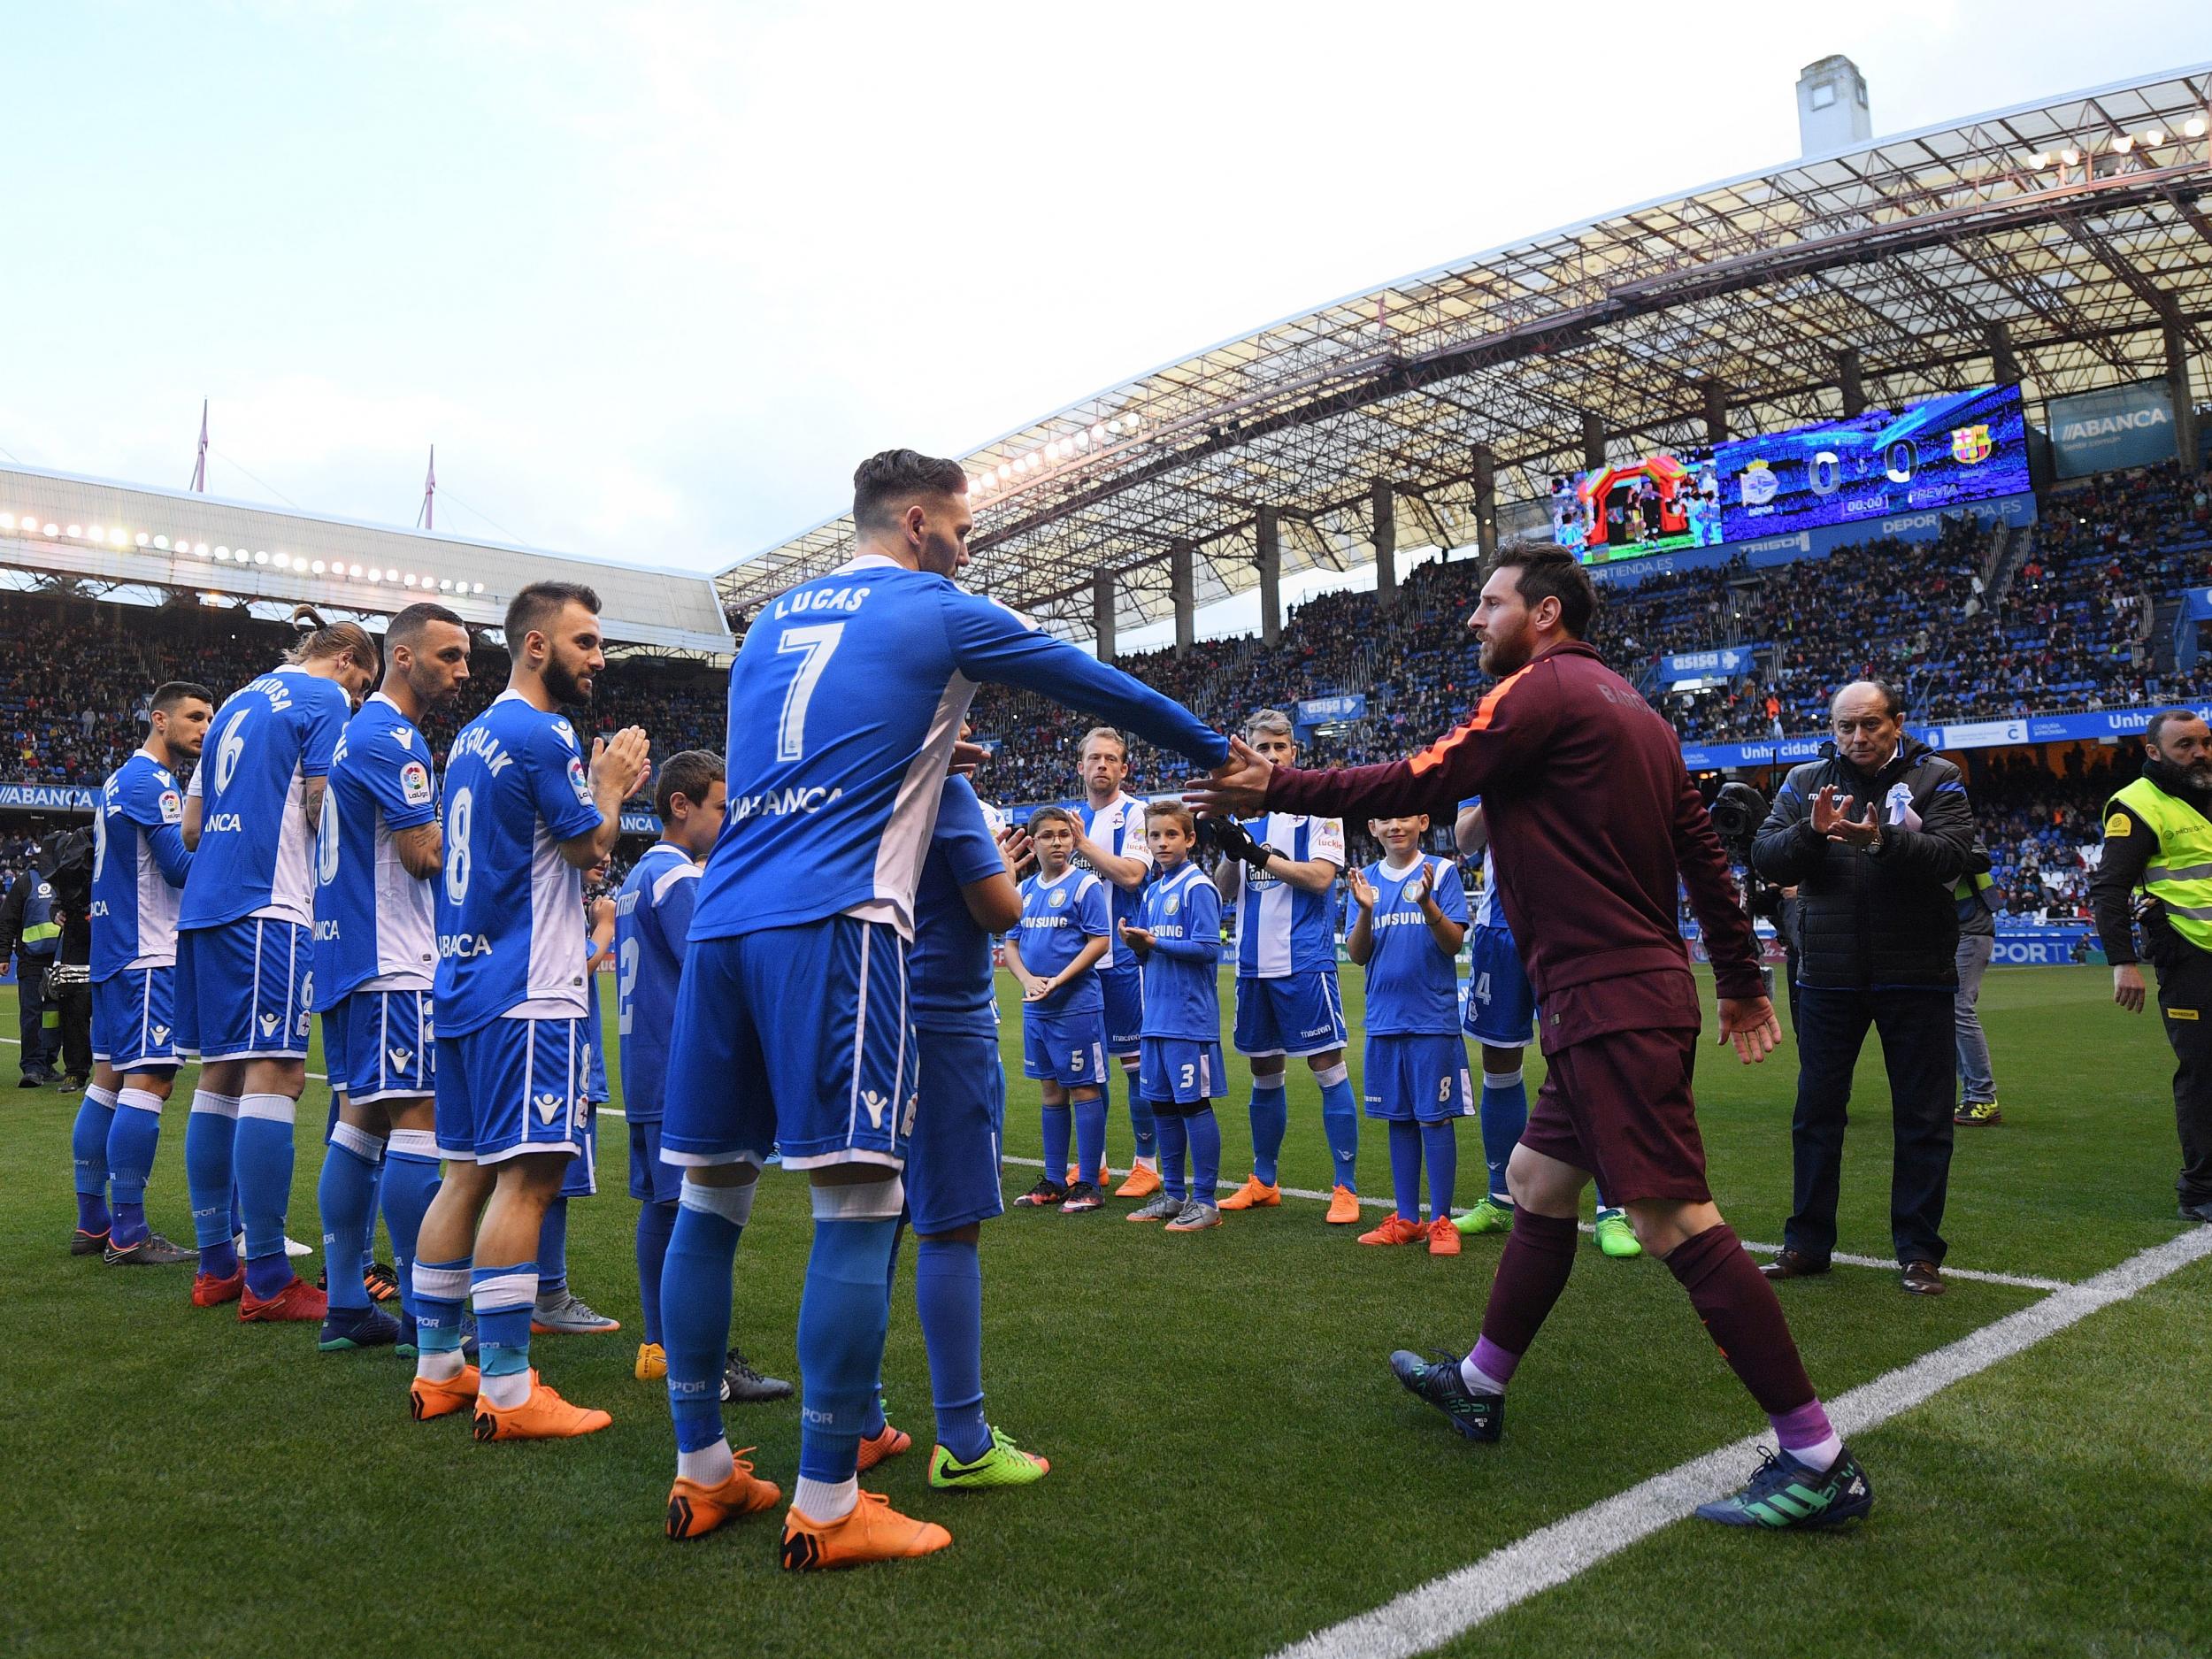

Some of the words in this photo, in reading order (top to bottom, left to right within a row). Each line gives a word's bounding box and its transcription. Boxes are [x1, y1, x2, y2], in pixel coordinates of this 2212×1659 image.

[2070, 408, 2167, 441] ABANCA
[1809, 451, 1841, 496] 0
[1886, 439, 1918, 483] 0
[1582, 557, 1674, 580] ORTIENDA.ES
[775, 588, 871, 620] LUCAS
[776, 622, 845, 763] 7
[1596, 683, 1648, 713] BARC
[215, 708, 252, 797] 6
[1780, 741, 1822, 757] cidad
[7, 788, 94, 807] ABANCA
[446, 787, 472, 906] 8
[1022, 917, 1068, 928] MSUNG
[1150, 925, 1184, 938] SUNG
[301, 971, 313, 1010] 6
[1475, 972, 1492, 1006] 4
[1301, 1025, 1332, 1040] macron
[1071, 1049, 1085, 1072] 5
[1179, 1064, 1194, 1089] 3
[1439, 1076, 1452, 1102] 8
[416, 1315, 440, 1328] POR
[803, 1406, 833, 1425] POR
